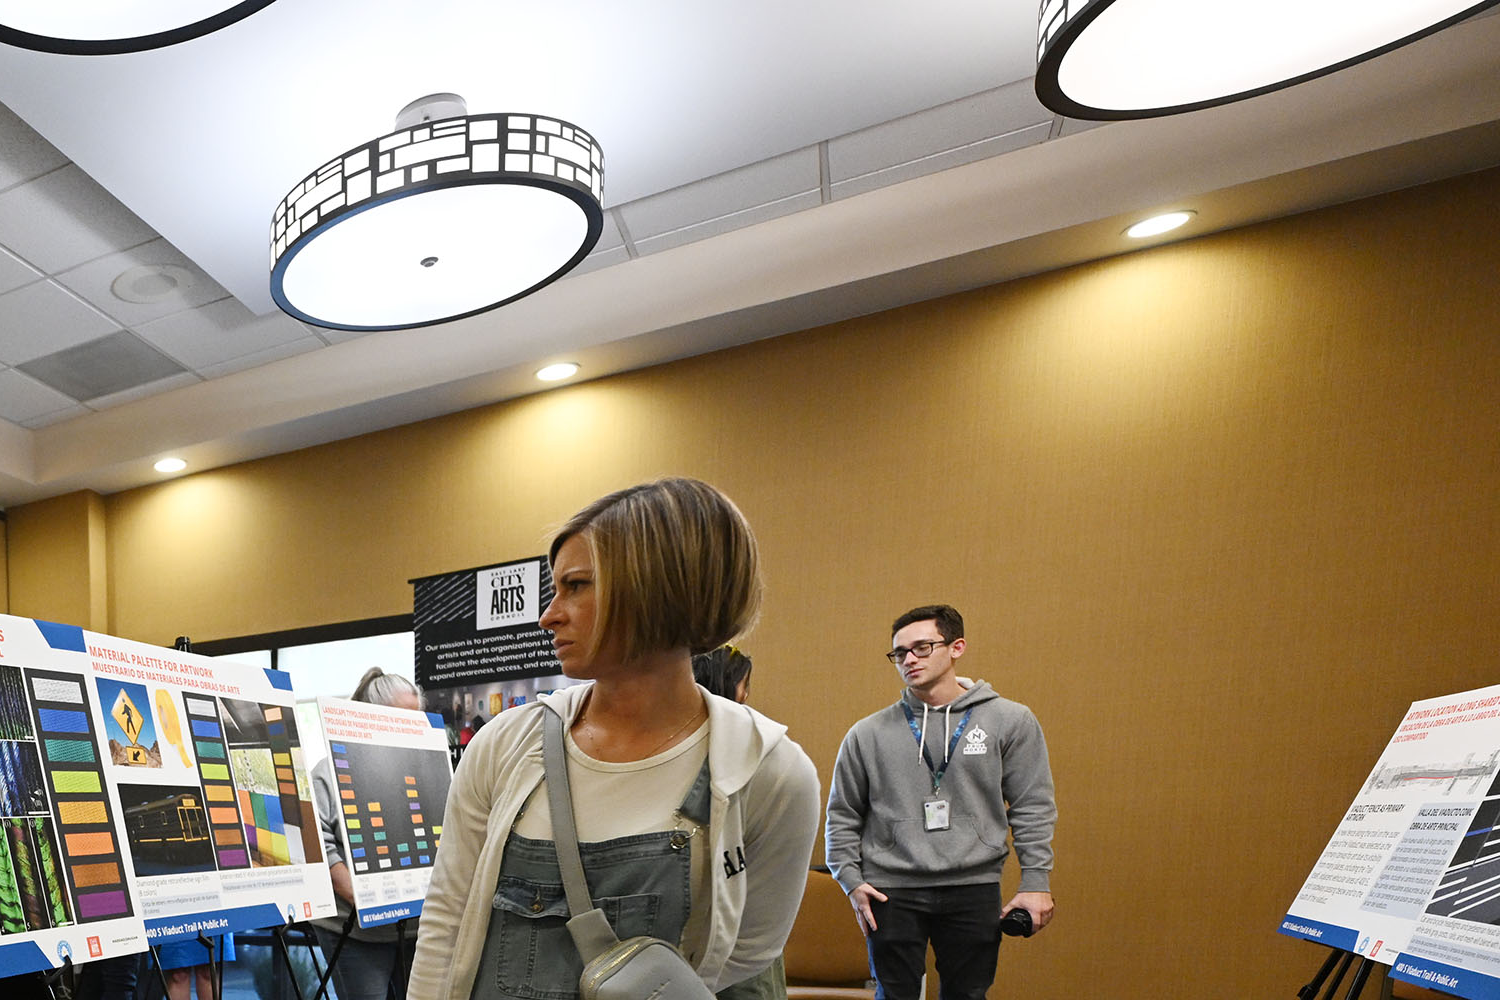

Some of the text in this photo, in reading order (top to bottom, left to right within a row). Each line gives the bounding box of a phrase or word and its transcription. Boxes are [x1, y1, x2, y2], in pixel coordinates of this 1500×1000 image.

[491, 573, 522, 588] CITY
[491, 585, 524, 615] ARTS
[437, 650, 459, 660] artists
[460, 647, 474, 656] and
[476, 646, 489, 655] arts
[491, 640, 540, 653] organizations
[440, 641, 465, 650] mission
[482, 634, 515, 645] promote,
[517, 629, 547, 639] present,
[89, 646, 214, 678] MATERIAL PALETTE FOR ARTWORK
[436, 660, 465, 670] facilitate
[480, 652, 527, 665] development
[538, 649, 549, 657] the
[92, 662, 240, 694] MUESTRARIO DE MATERIALES PARA OBRAS DE ARTE
[429, 672, 455, 681] expand
[456, 667, 495, 677] awareness,
[496, 663, 522, 672] access,
[524, 660, 538, 669] and
[27, 921, 30, 929] 5
[147, 929, 157, 938] 400
[158, 928, 161, 937] S
[162, 924, 184, 936] Viaduct
[184, 922, 197, 933] Trail
[203, 920, 219, 930] Public
[220, 919, 228, 927] Art
[1406, 966, 1423, 977] Viaduct
[1421, 970, 1434, 980] Trail
[1436, 974, 1450, 986] Public
[1449, 978, 1458, 988] Art
